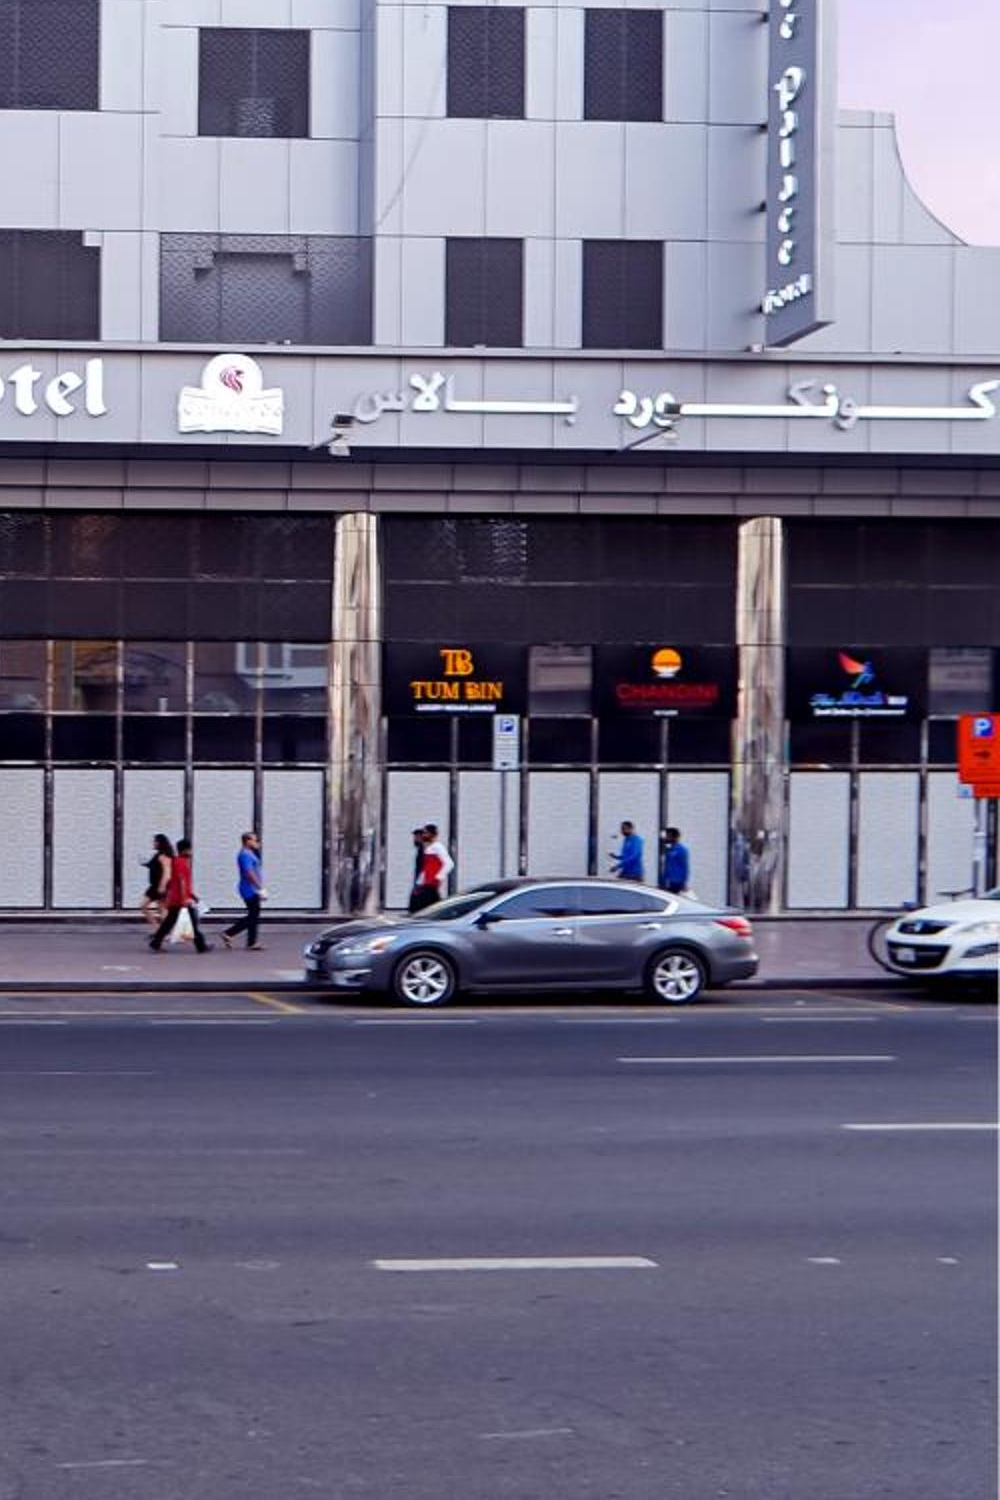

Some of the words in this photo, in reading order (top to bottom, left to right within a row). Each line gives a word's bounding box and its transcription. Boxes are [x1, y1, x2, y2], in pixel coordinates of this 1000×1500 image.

[440, 649, 474, 676] TB
[410, 681, 459, 700] TUM
[465, 681, 503, 700] BIN
